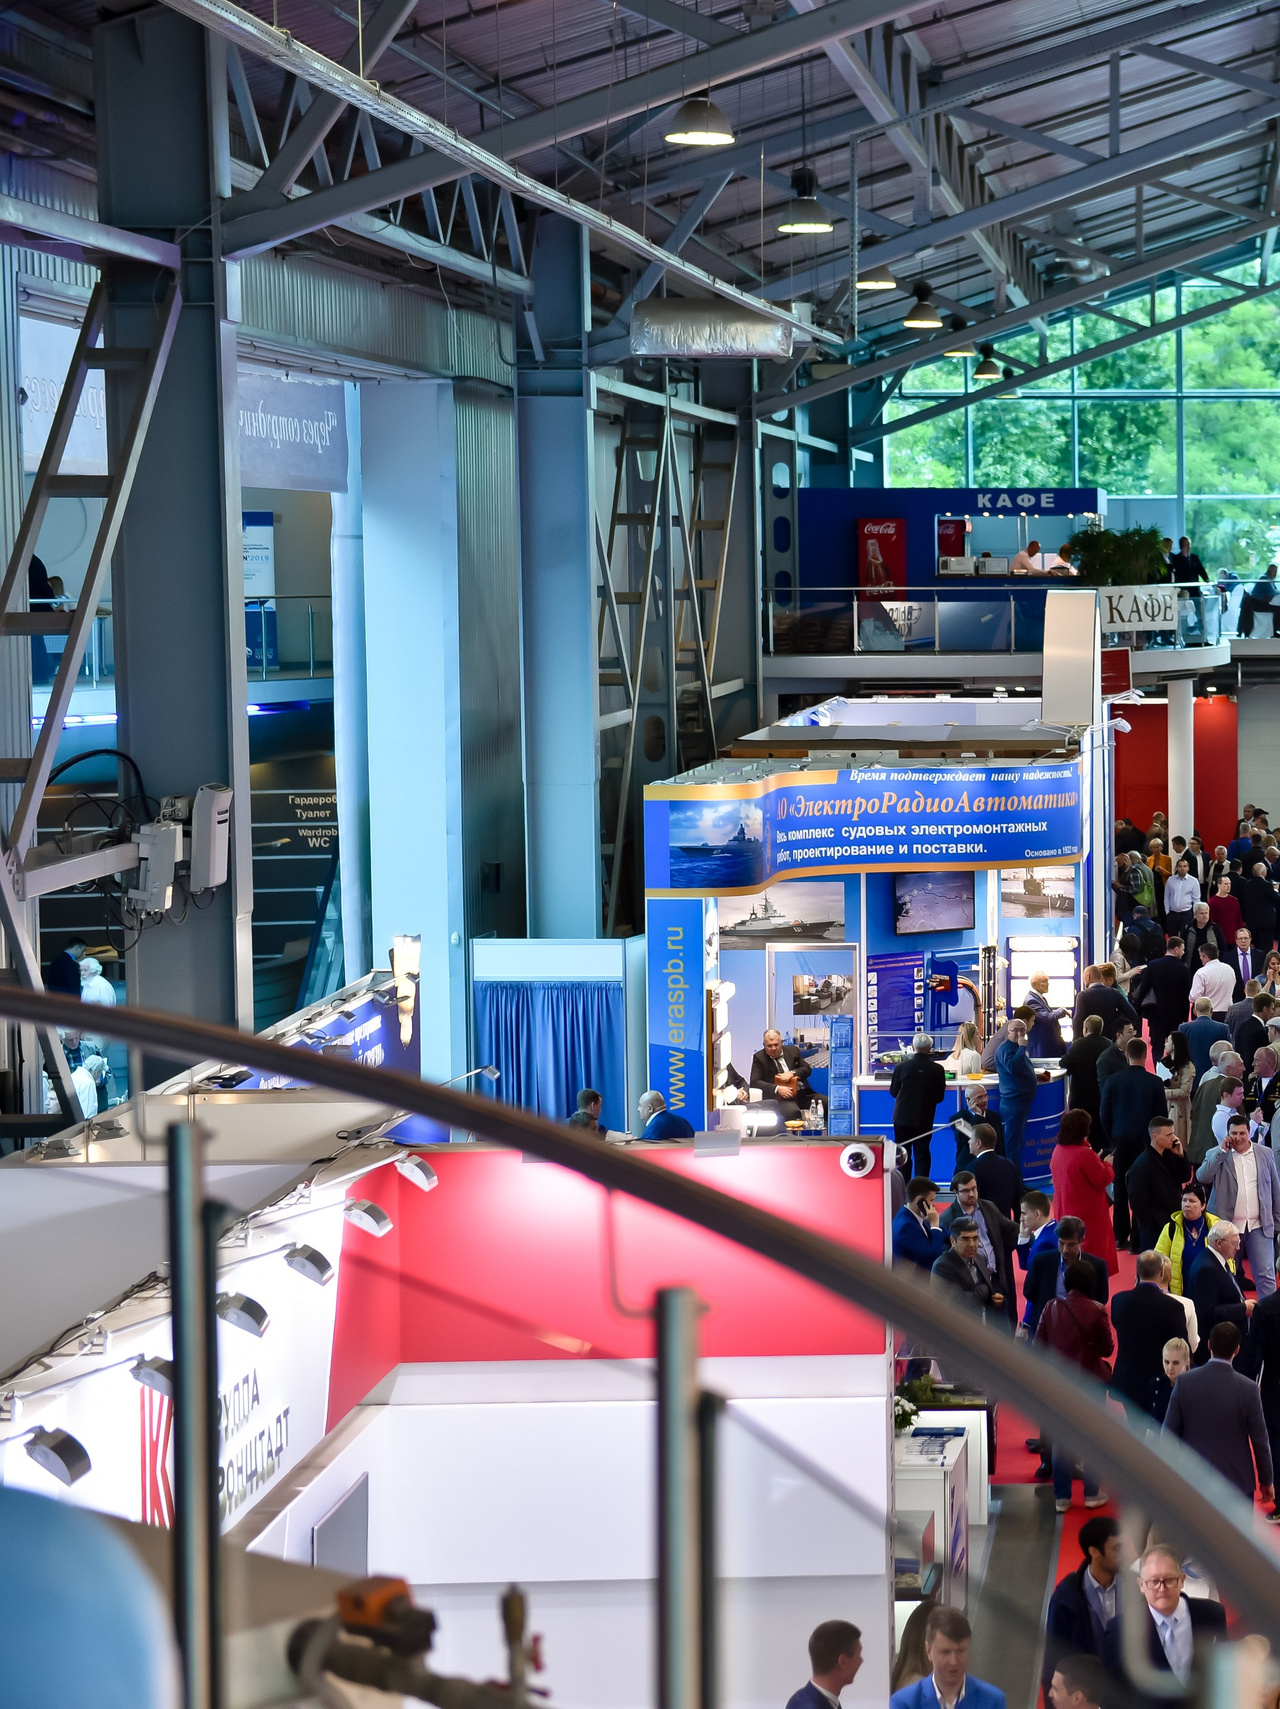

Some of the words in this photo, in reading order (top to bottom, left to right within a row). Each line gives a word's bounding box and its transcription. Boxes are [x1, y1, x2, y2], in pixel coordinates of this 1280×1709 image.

[977, 493, 1055, 508] КАФЕ
[1105, 593, 1174, 625] КАФЕ
[849, 769, 887, 784] Время
[889, 770, 986, 784] подтверждает
[990, 772, 1021, 784] нашу
[1022, 766, 1073, 781] надежность!
[288, 795, 337, 806] Гардероб
[776, 796, 788, 821] АО
[295, 809, 331, 820] Туалет
[788, 827, 835, 841] комплекс
[841, 825, 907, 840] судовых
[910, 821, 1048, 838] электромонтажных
[308, 837, 330, 848] WC
[792, 845, 894, 860] проектирование
[899, 844, 908, 854] и
[912, 843, 988, 854] поставки.
[1024, 848, 1057, 858] Основано
[662, 926, 690, 1111] www.eraspb.ru
